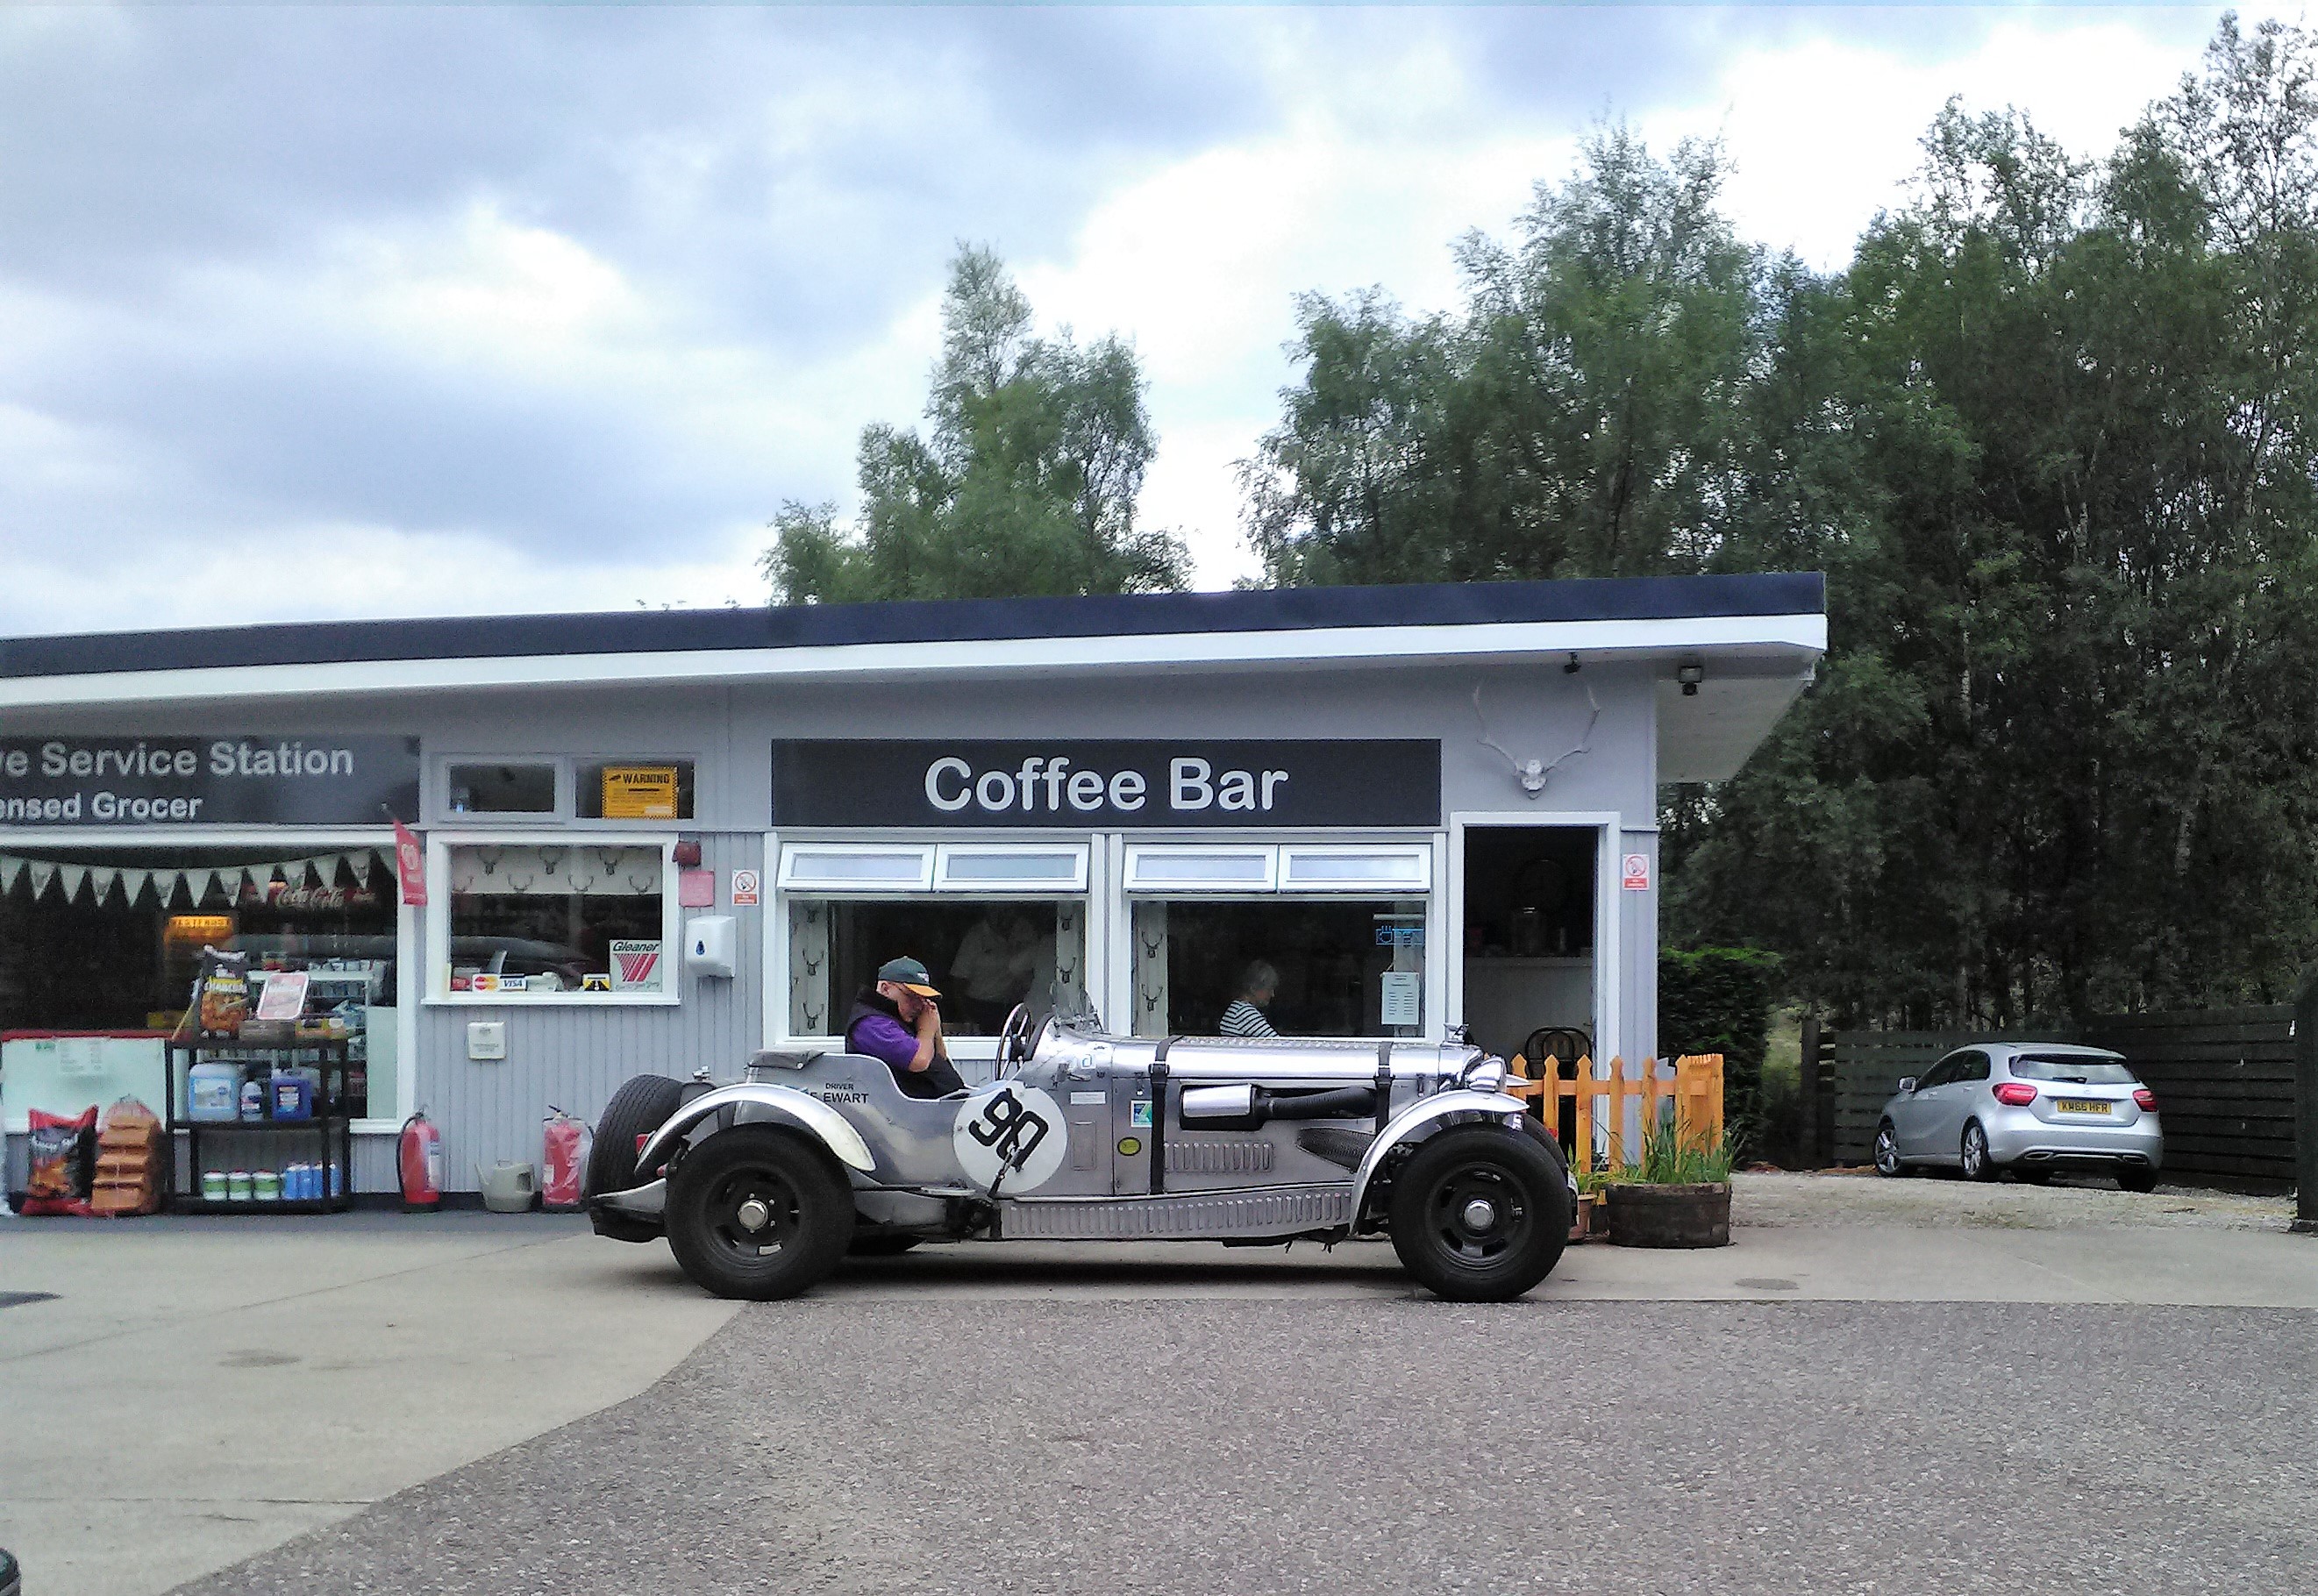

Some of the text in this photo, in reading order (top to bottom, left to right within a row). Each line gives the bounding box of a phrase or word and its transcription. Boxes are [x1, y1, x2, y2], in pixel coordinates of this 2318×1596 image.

[0, 740, 353, 778] e Service Station
[623, 773, 670, 784] WARNING
[924, 756, 1289, 811] Coffee Bar
[91, 791, 204, 821] Grocer
[613, 941, 660, 951] Gleaner
[503, 979, 523, 987] VISA
[825, 1082, 854, 1091] DRIVER
[968, 1089, 1049, 1169] 90
